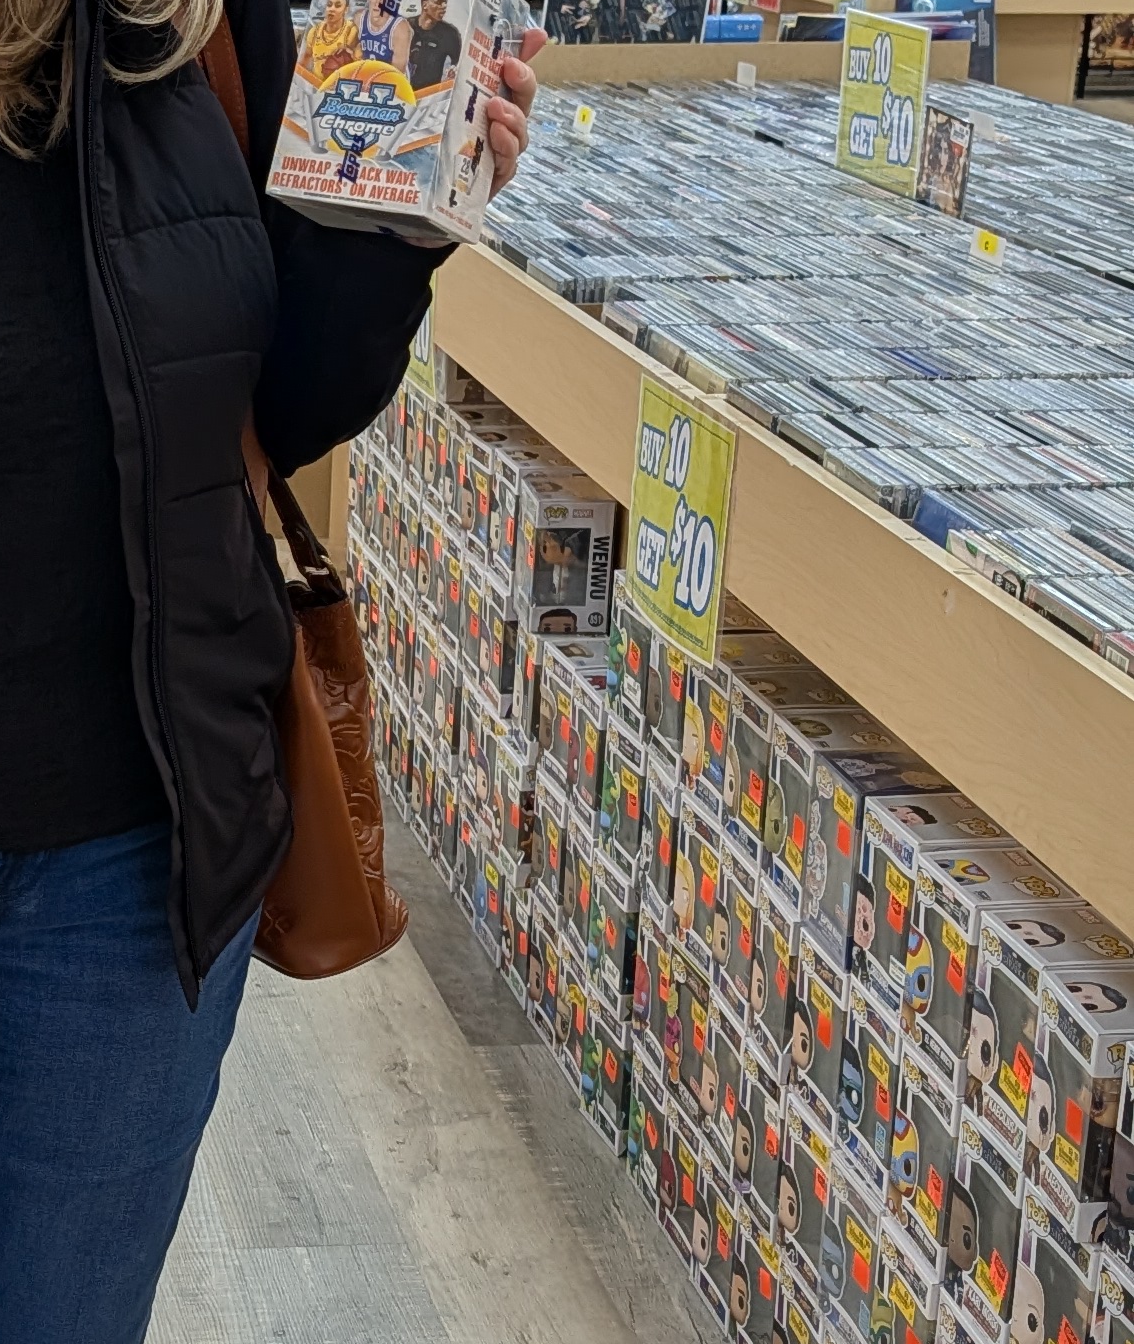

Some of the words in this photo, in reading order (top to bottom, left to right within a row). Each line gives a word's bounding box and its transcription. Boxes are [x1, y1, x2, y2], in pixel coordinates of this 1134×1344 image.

[848, 48, 871, 82] BUY
[872, 33, 892, 85] 10
[319, 96, 402, 123] Bowman
[319, 114, 396, 137] Chrome
[849, 113, 879, 159] GET
[881, 89, 914, 166] $10
[281, 156, 332, 178] UNWRAP
[385, 168, 418, 187] WAVE
[349, 182, 367, 197] ON
[368, 185, 421, 205] AVERAGE
[639, 423, 666, 479] BUY
[664, 415, 692, 492] 10
[589, 535, 611, 601] WENWU
[636, 517, 668, 591] GET
[670, 494, 716, 618] $10
[1100, 1269, 1125, 1314] POP!
